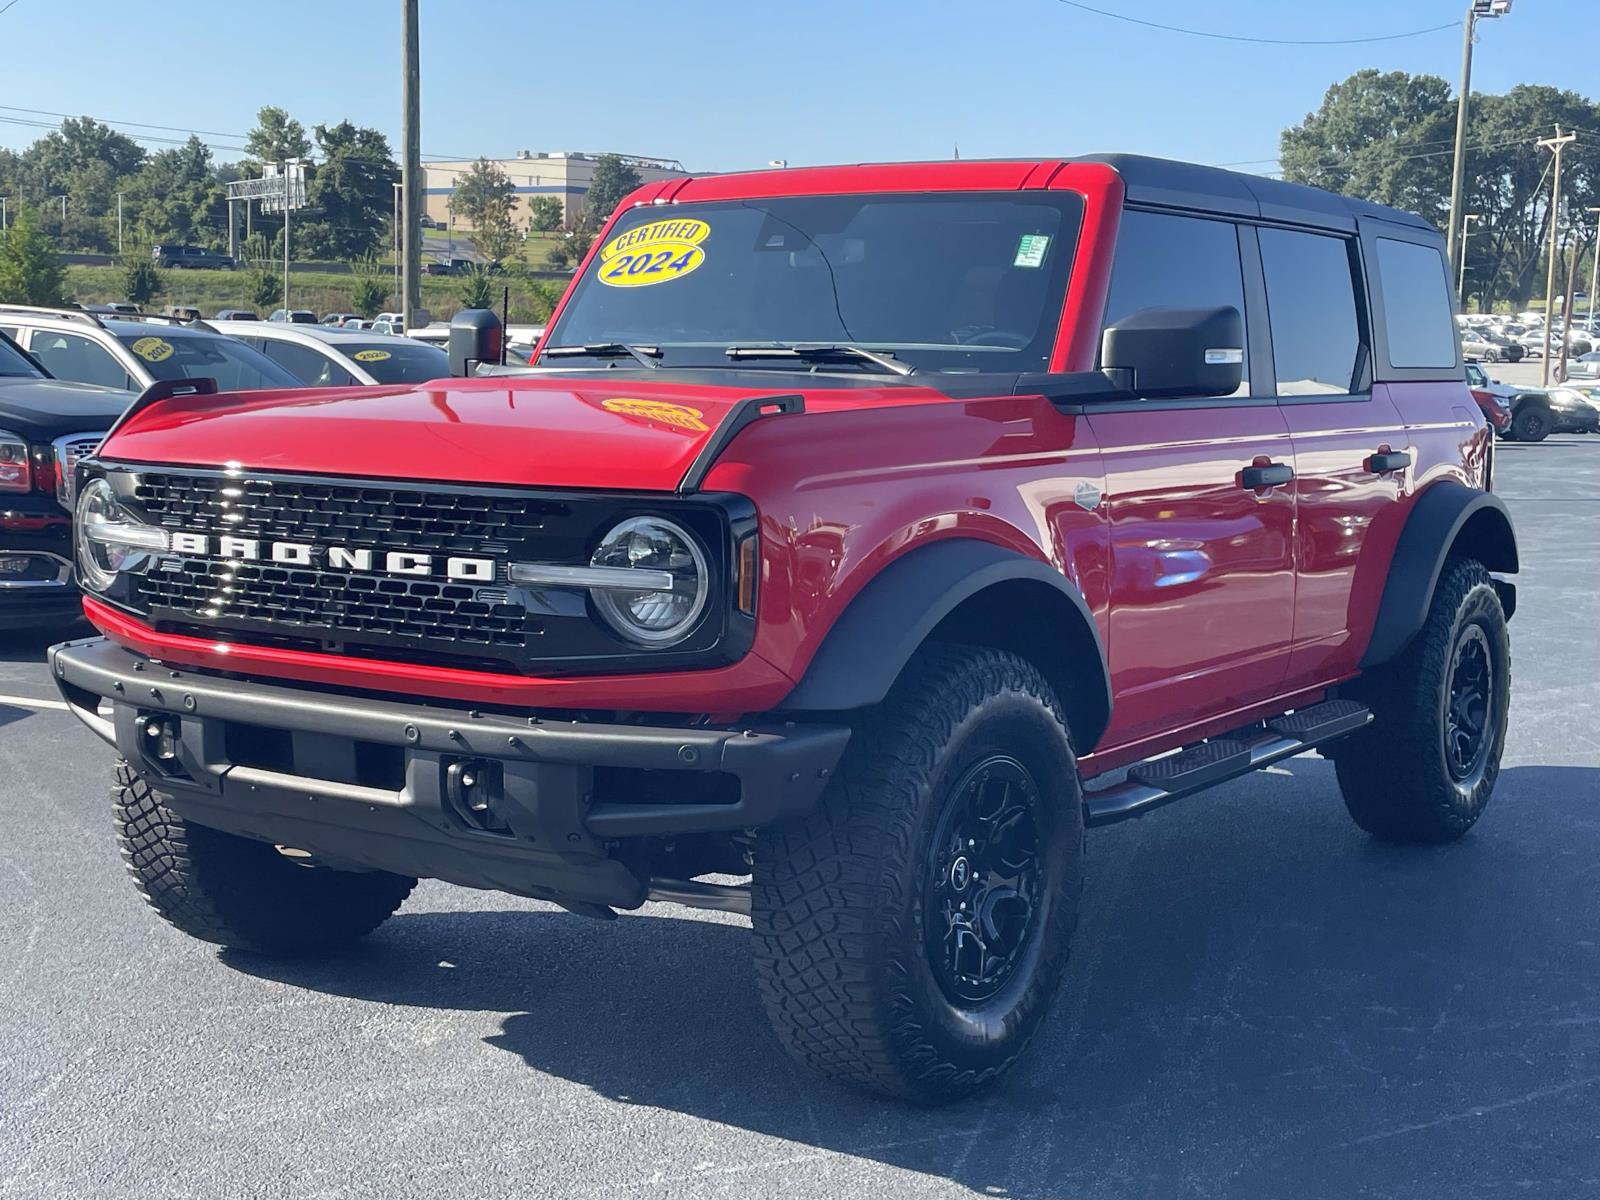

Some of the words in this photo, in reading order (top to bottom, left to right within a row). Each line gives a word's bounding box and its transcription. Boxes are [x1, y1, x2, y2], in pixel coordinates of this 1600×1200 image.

[615, 222, 701, 250] CERTIFIED
[606, 249, 697, 278] 2024
[173, 532, 496, 581] BRONCO
